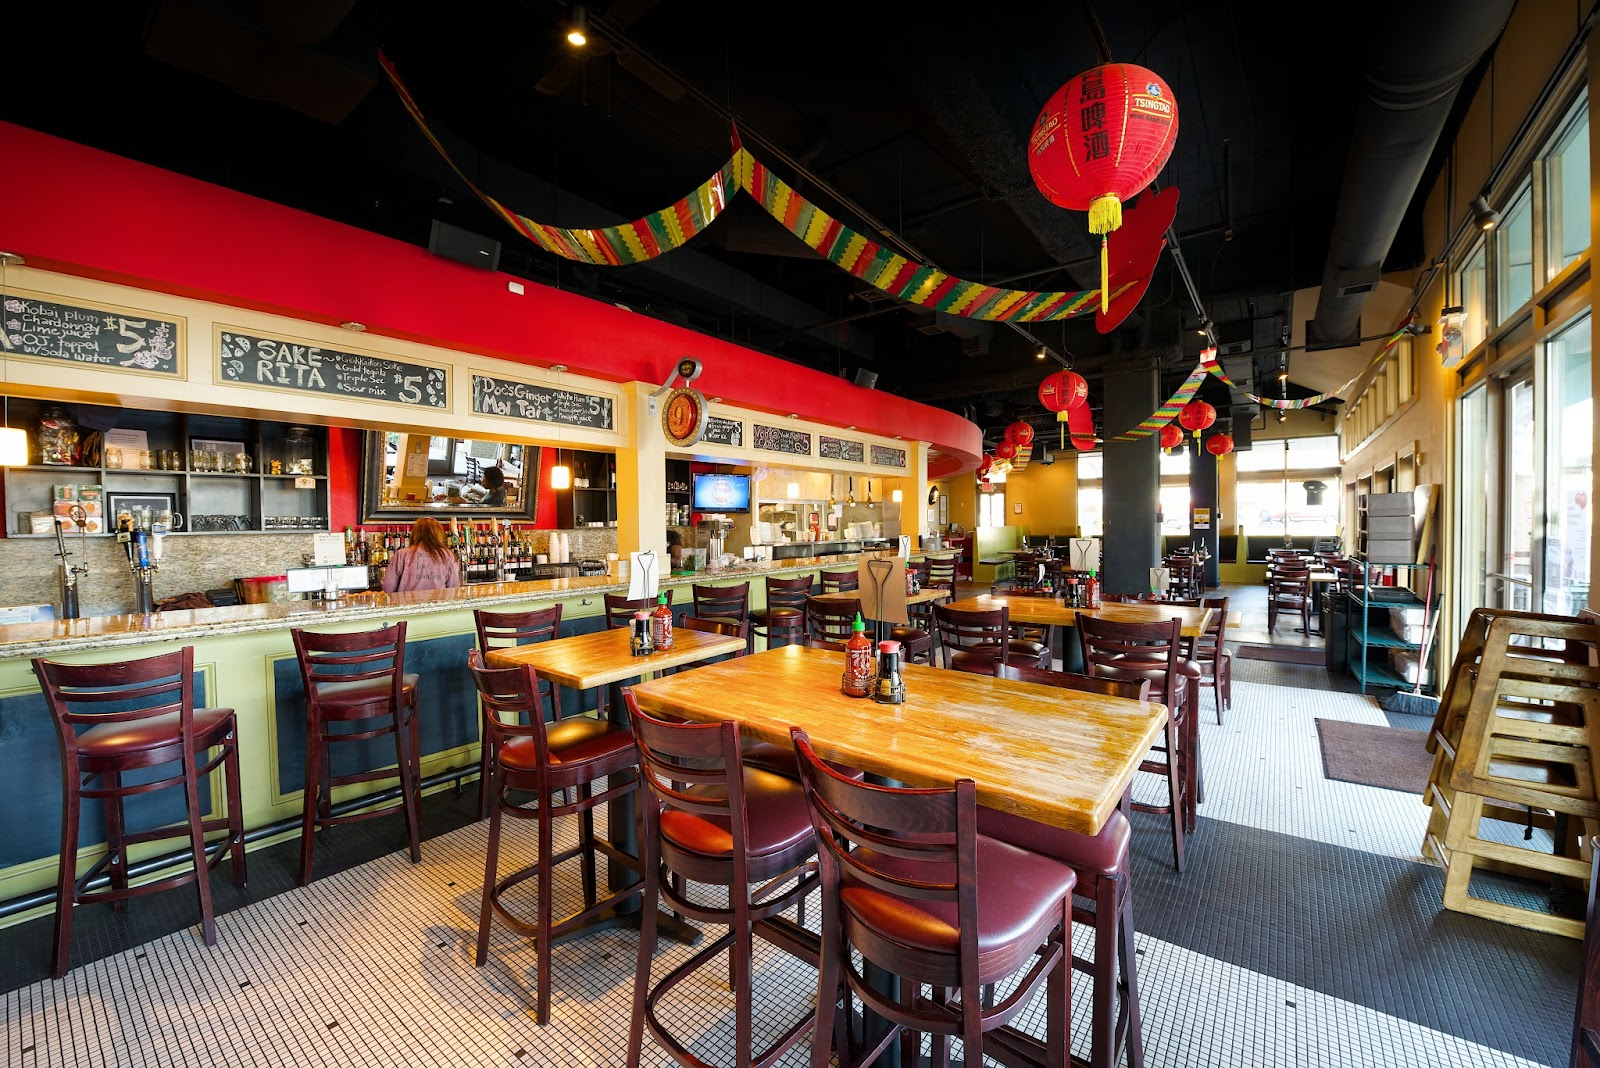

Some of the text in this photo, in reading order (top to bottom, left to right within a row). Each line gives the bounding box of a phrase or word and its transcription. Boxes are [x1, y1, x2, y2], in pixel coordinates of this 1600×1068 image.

[1134, 98, 1171, 113] TSINGTAO
[22, 301, 58, 318] Kobai
[22, 314, 100, 335] Chardonnay
[22, 322, 93, 338] Lime juice
[103, 316, 147, 353] $5
[57, 338, 99, 353] topped
[257, 340, 322, 367] SAKE
[257, 360, 326, 388] RITA
[342, 364, 360, 372] Gold
[342, 373, 386, 385] Triple Sec
[394, 372, 423, 404] $5
[343, 383, 387, 396] Sour mix
[482, 378, 552, 405] Doc's Ginger
[483, 394, 542, 419] Mai Tai
